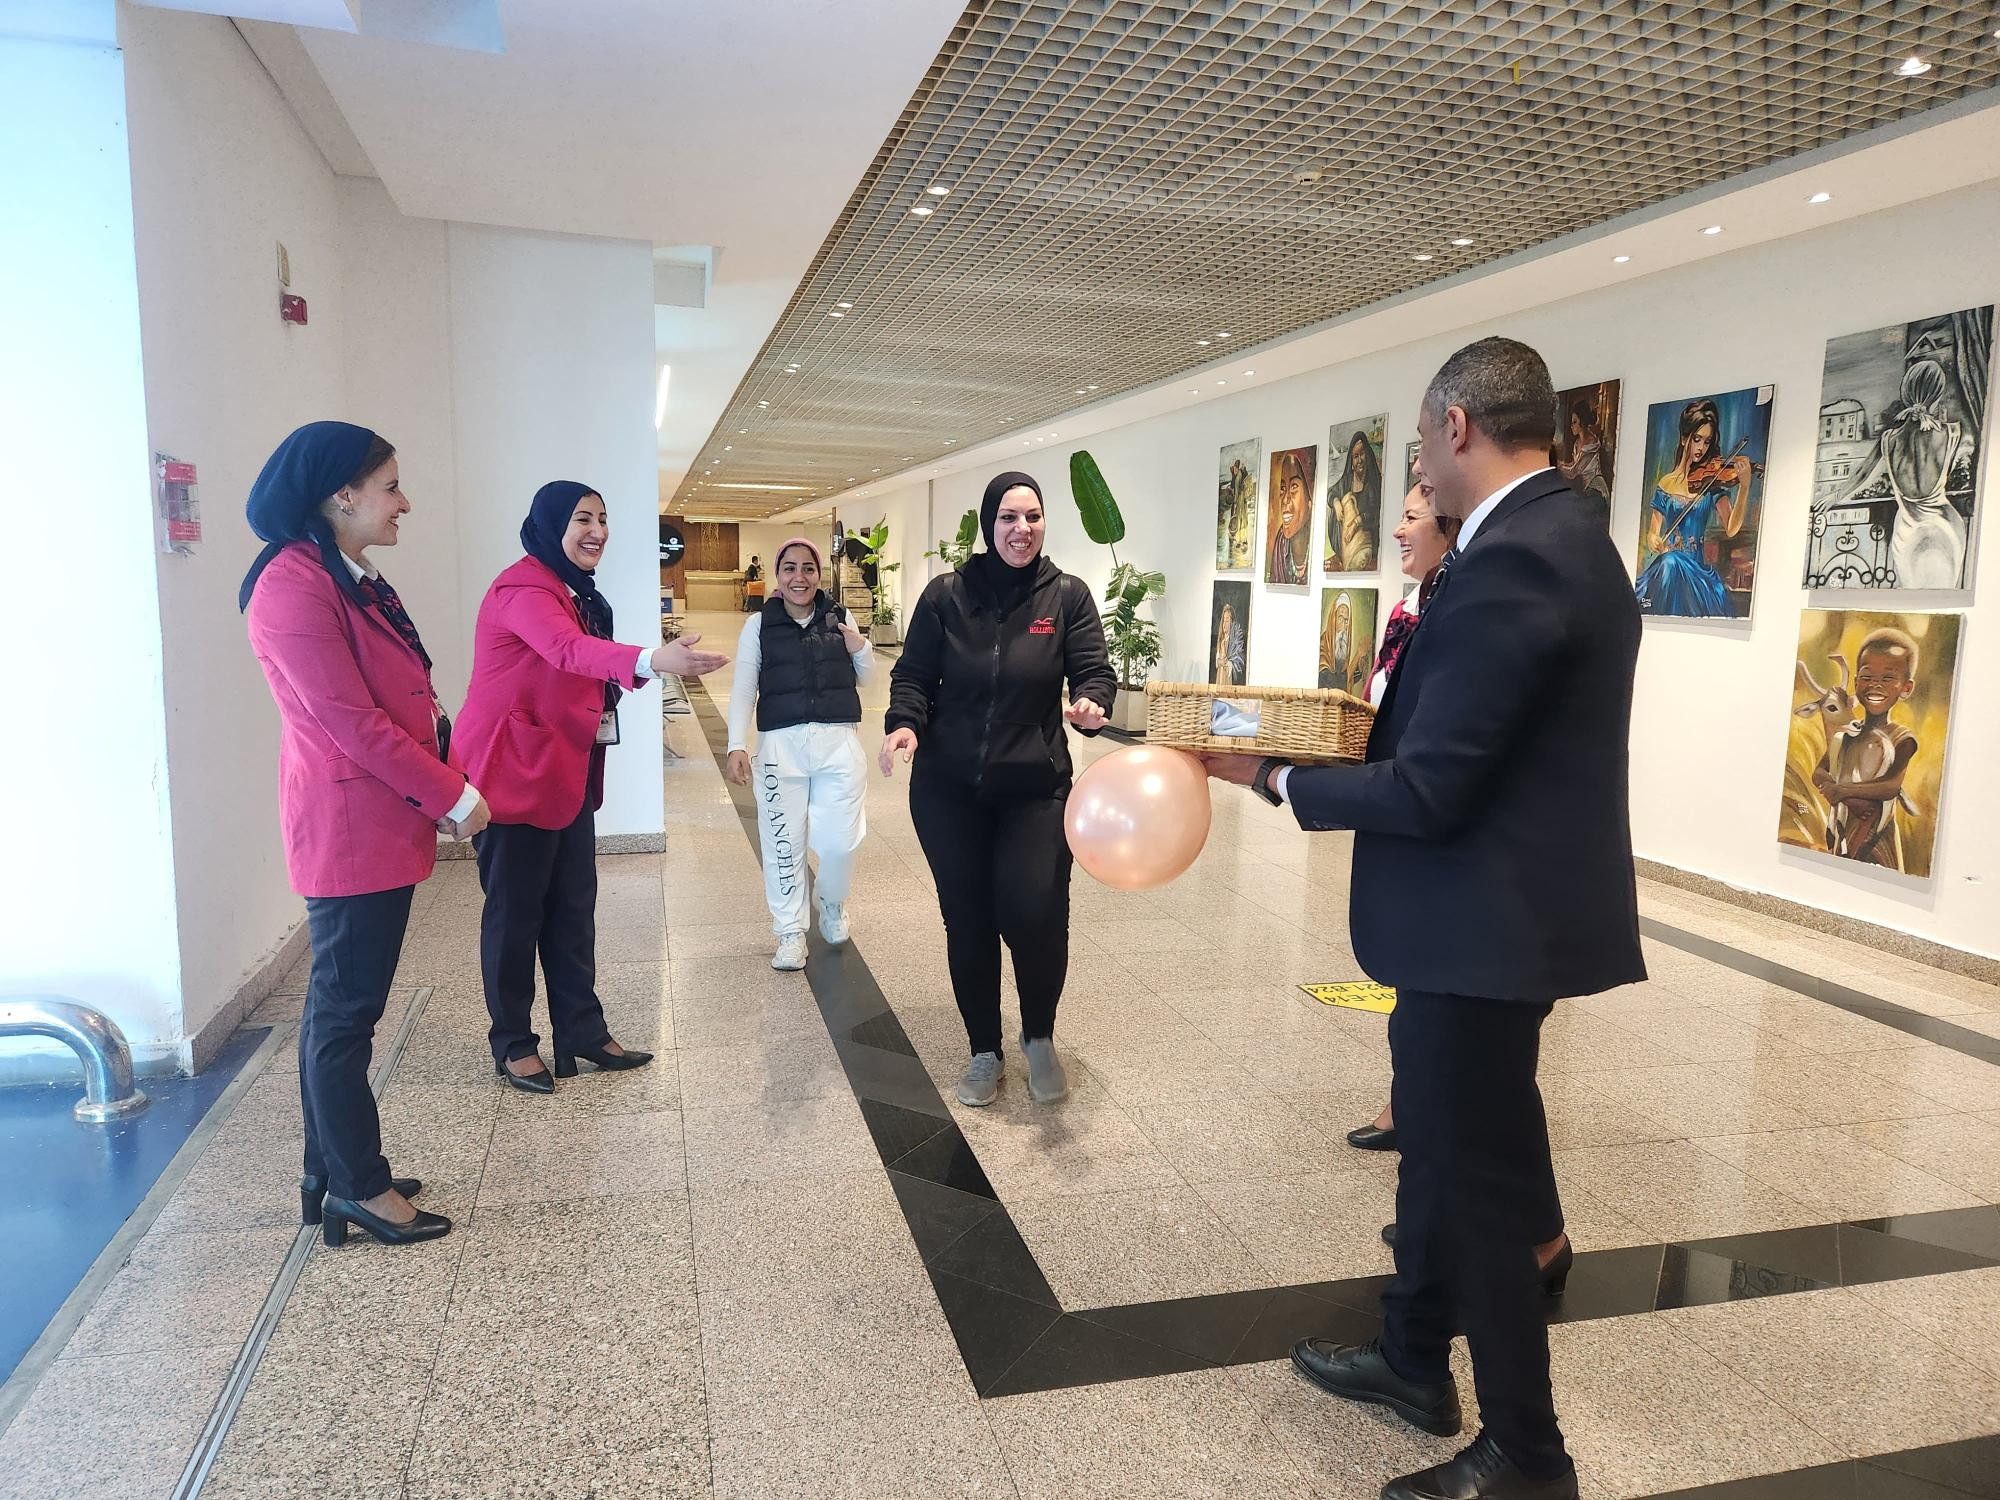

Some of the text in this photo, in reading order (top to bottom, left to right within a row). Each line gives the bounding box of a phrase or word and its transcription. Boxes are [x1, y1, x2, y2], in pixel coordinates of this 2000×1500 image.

[764, 762, 797, 896] LOS ANGELES
[1307, 984, 1383, 994] 21-B24
[1324, 992, 1396, 1003] 01-E14
